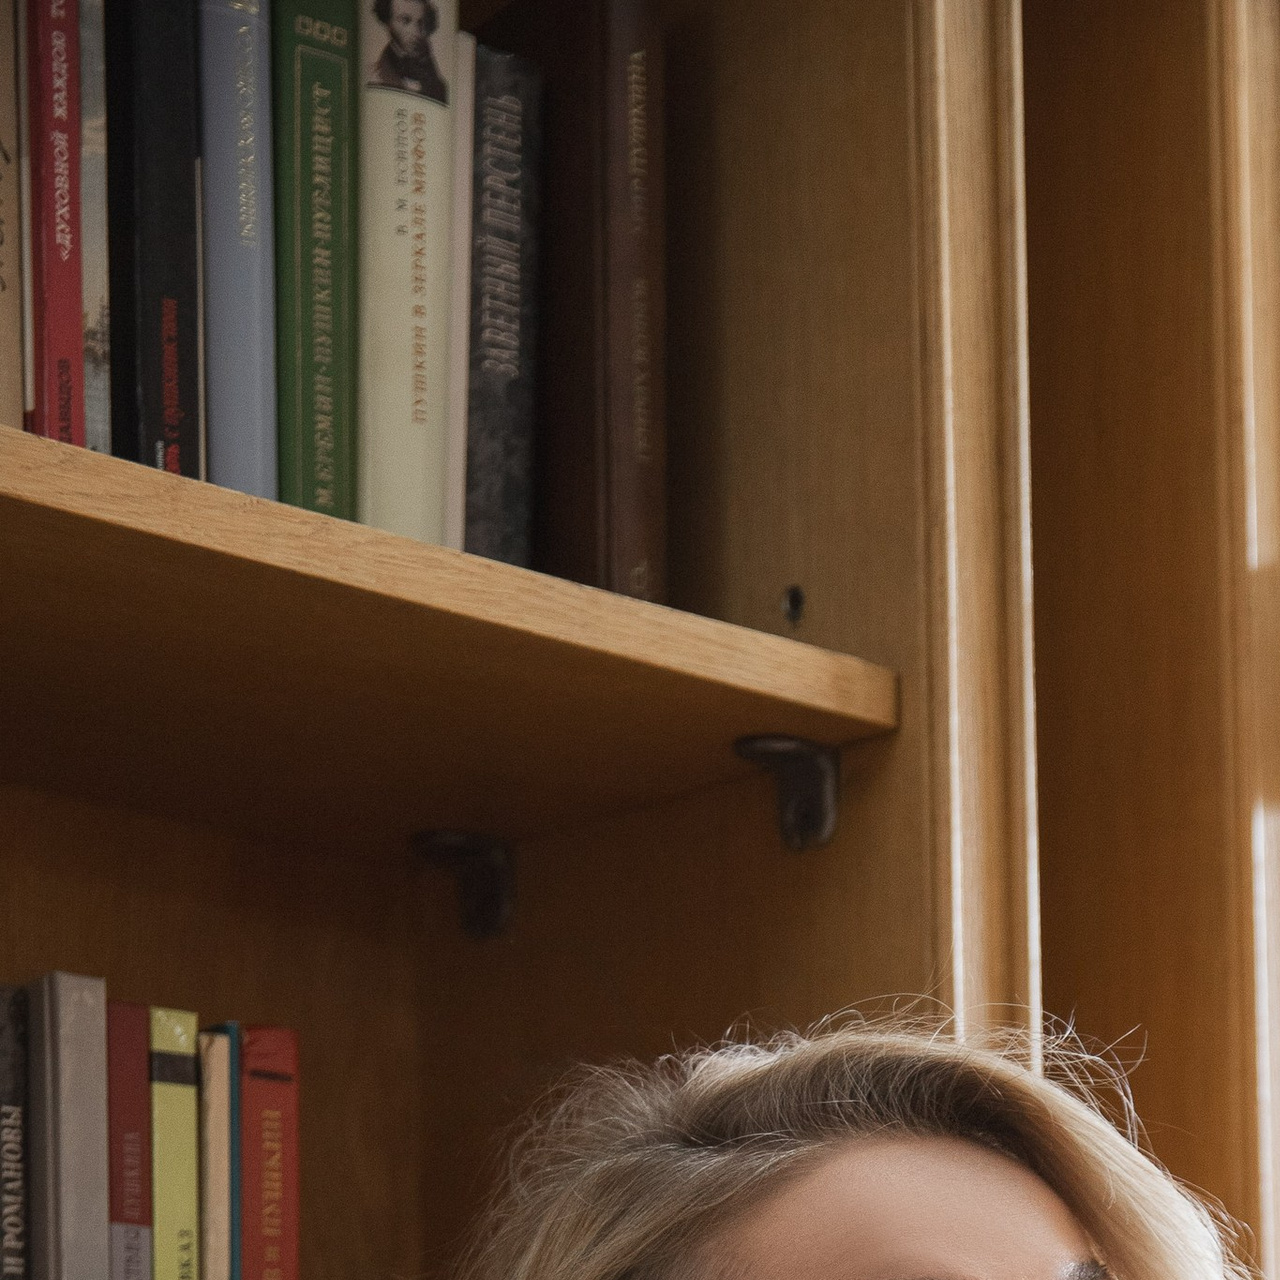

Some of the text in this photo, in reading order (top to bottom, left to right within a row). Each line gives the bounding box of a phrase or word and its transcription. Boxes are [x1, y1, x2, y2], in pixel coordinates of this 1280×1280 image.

[410, 113, 427, 195] МИФОВ
[410, 202, 427, 298] ЗЕРКАЛЕ
[476, 95, 523, 376] ЗАВЕТНЫЙ ПЕРСТЕНЬ
[410, 326, 428, 424] ПУШКИН
[0, 1104, 25, 1249] РОМАНОВЫ
[260, 1109, 283, 1237] ПУШКИН
[2, 1256, 25, 1275] И
